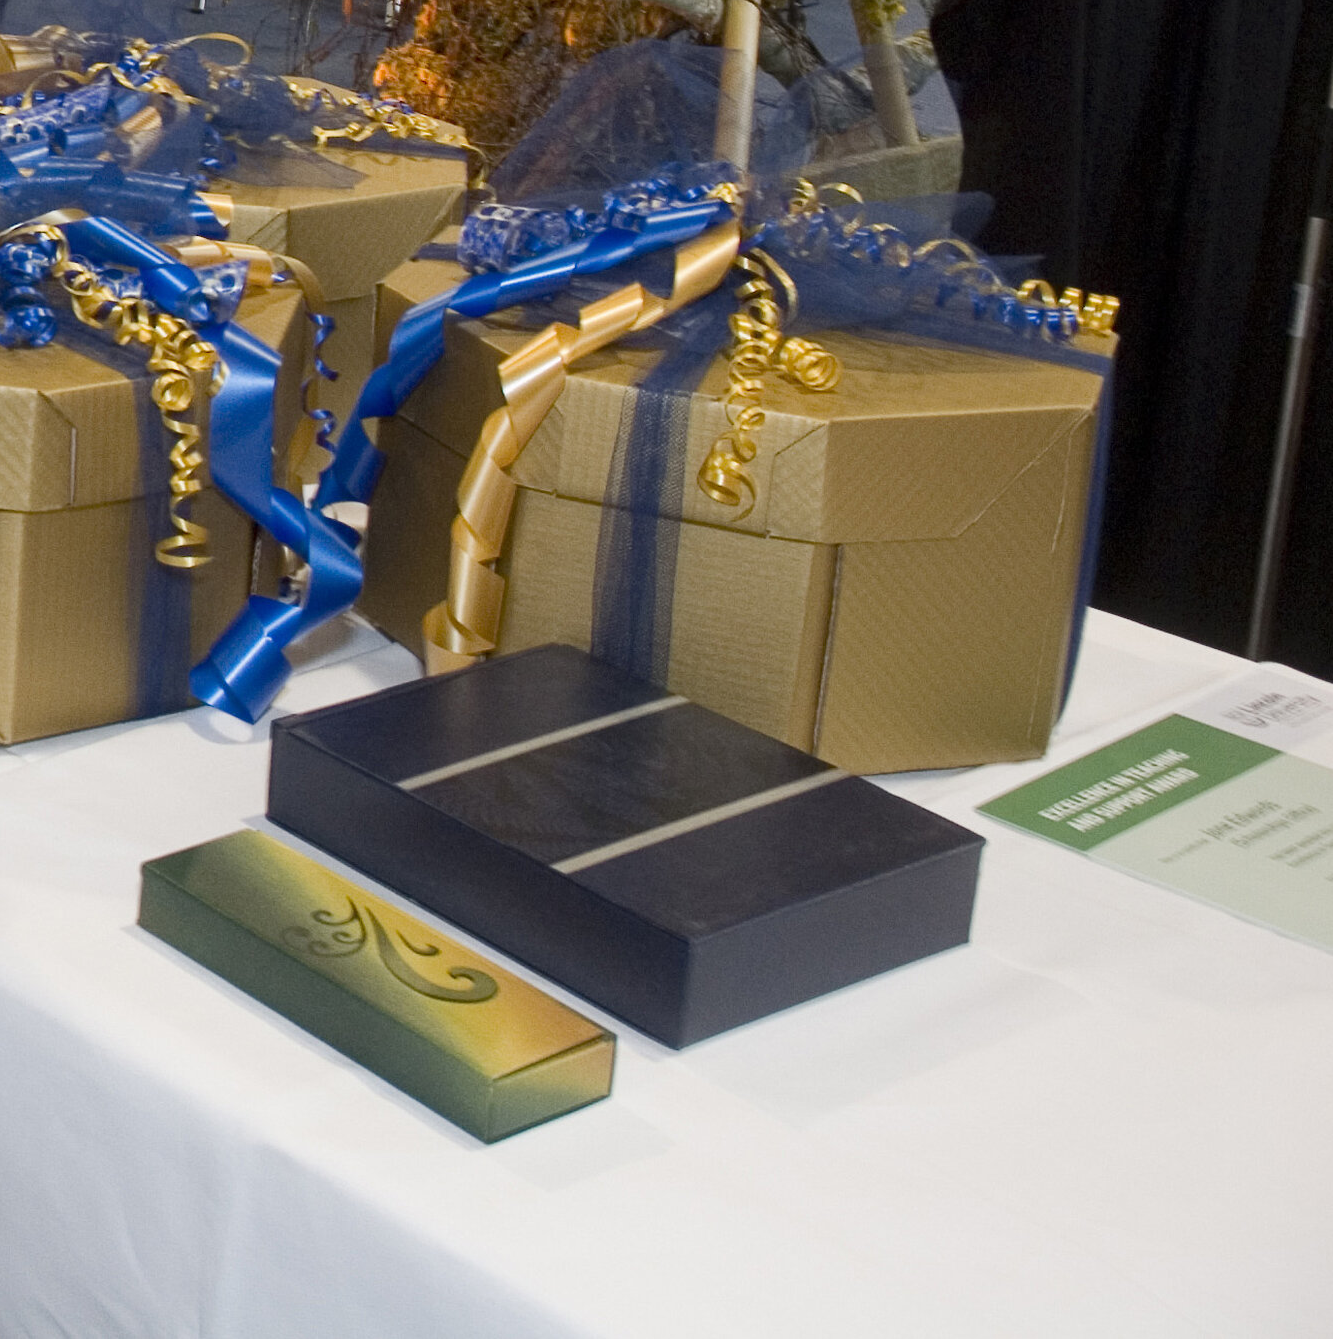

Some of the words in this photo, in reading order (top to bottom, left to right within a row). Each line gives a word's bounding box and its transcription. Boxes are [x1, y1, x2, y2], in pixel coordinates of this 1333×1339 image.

[1106, 773, 1137, 788] IN
[1119, 748, 1191, 781] TEACHING
[1036, 780, 1124, 822] EXCELLENCE
[1066, 813, 1106, 833] AND
[1091, 787, 1158, 819] SUPPORT
[1145, 767, 1200, 794] AWARD
